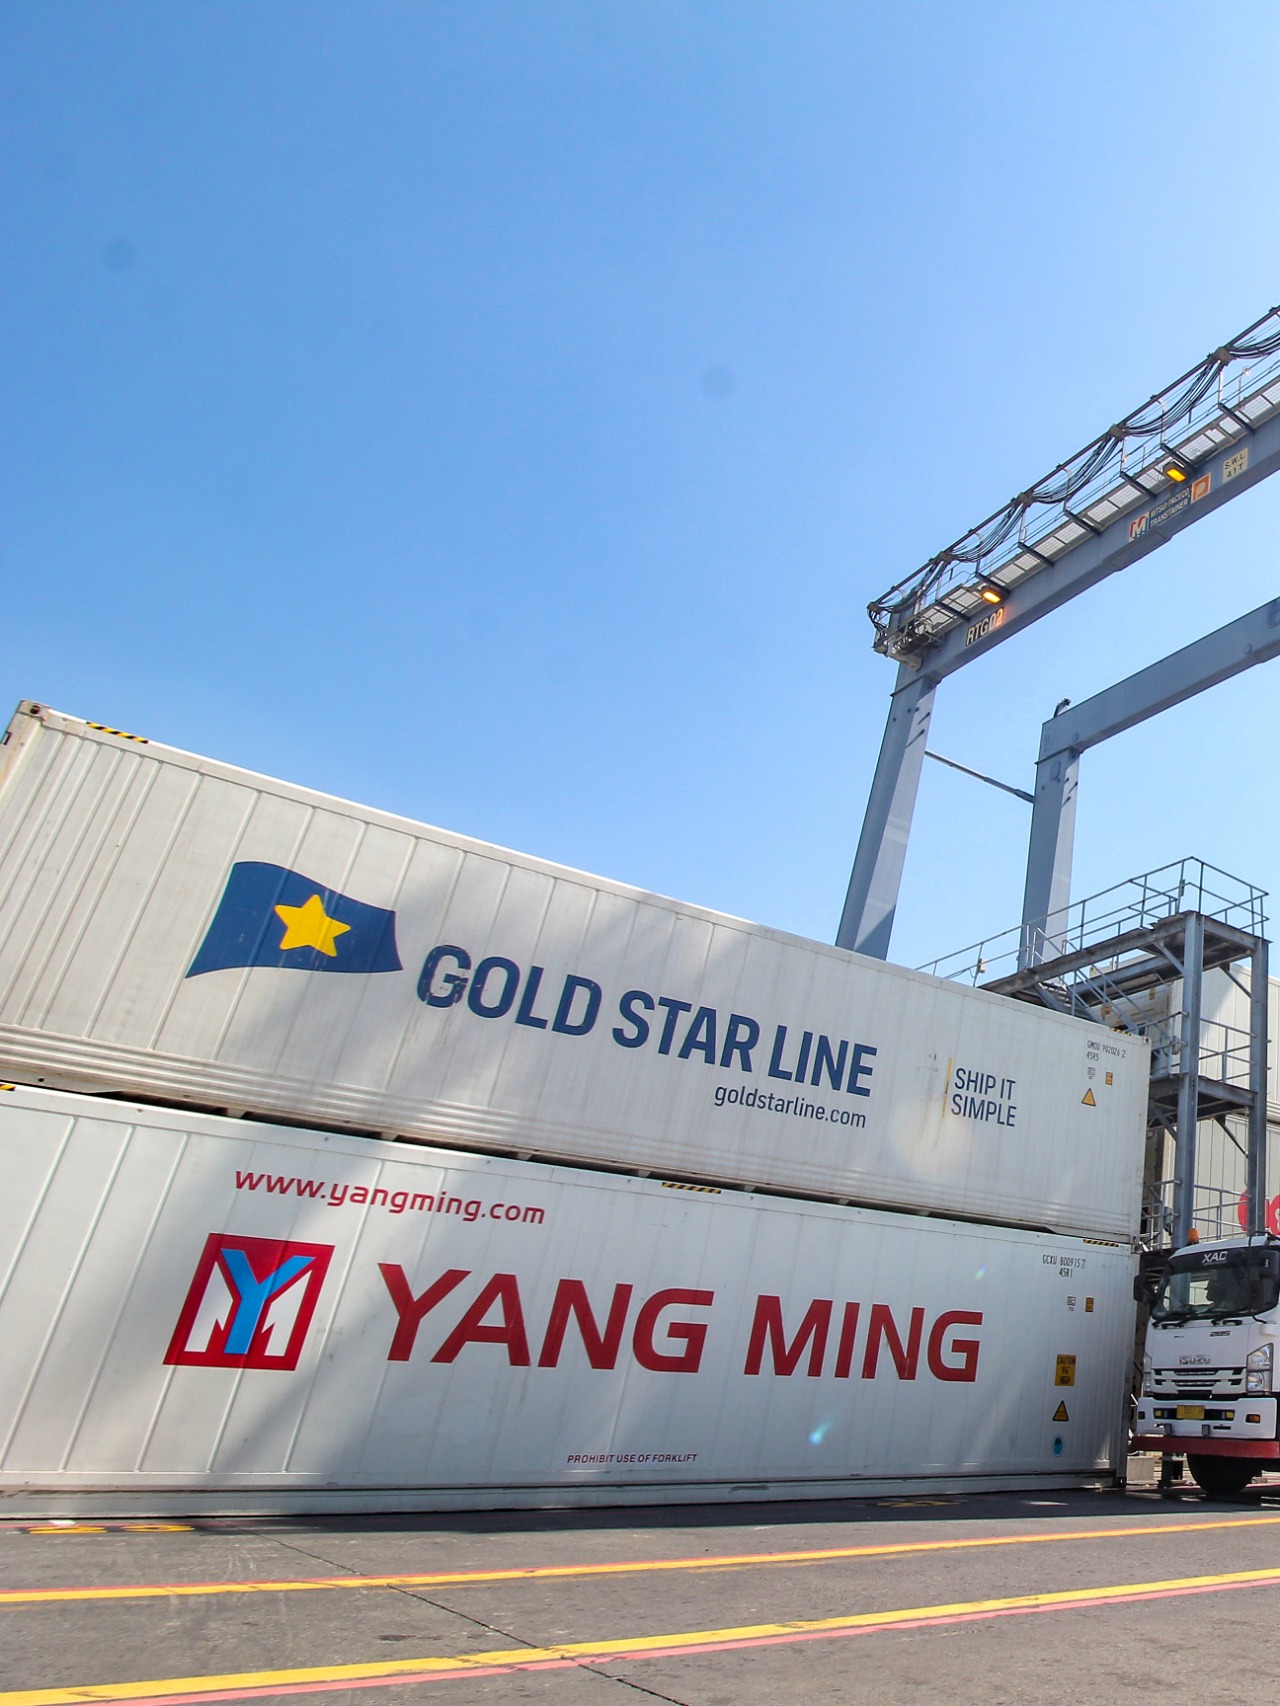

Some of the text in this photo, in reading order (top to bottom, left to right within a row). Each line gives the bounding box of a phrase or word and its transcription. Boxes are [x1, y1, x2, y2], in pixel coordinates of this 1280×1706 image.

[966, 607, 1005, 646] RTG02
[416, 943, 878, 1097] GOLD STAR LINE
[954, 1067, 1017, 1101] SHIP IT
[714, 1083, 867, 1129] goldstarline.com
[951, 1093, 1017, 1127] SIMPLE
[235, 1170, 546, 1225] www.yangming.com
[377, 1263, 984, 1383] YANG MING
[1179, 1354, 1211, 1365] ISUZU
[567, 1453, 698, 1464] PROHIBIT USE OF FORKLIFT
